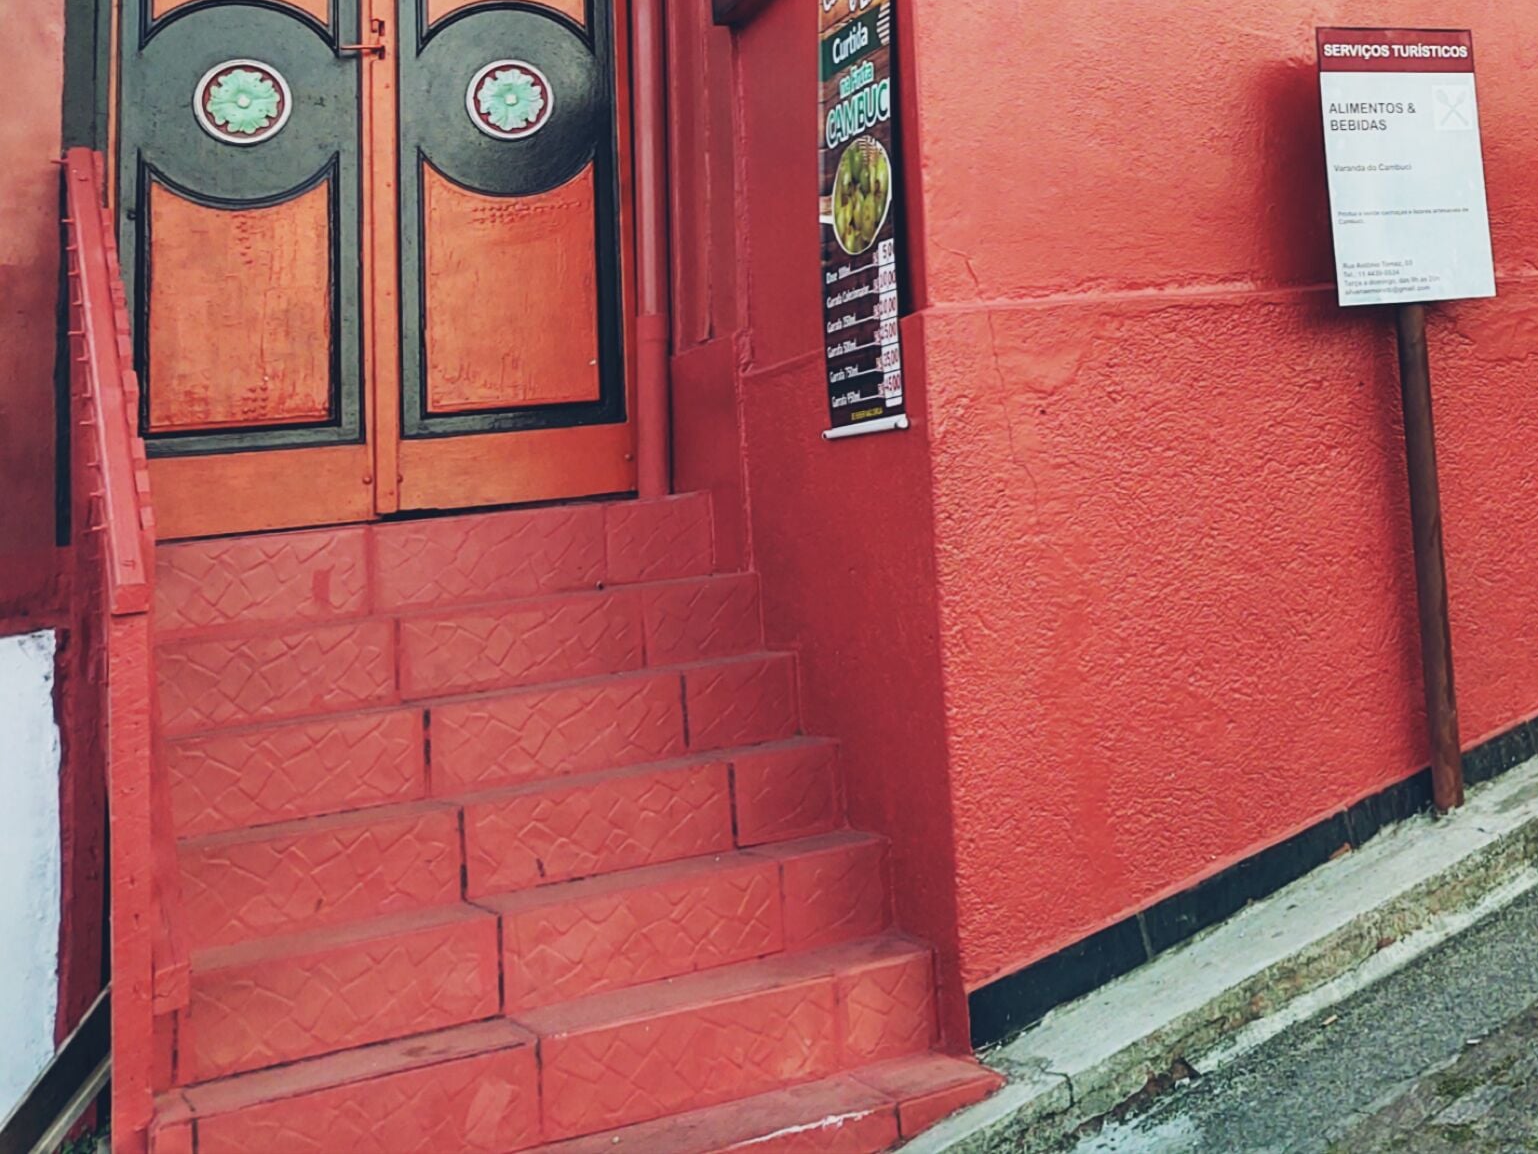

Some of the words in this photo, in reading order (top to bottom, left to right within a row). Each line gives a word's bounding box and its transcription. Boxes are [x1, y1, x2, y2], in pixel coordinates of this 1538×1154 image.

[832, 22, 869, 65] Curtida
[1323, 44, 1390, 59] SERVIÇOS
[1391, 43, 1468, 58] TURÍSTICOS
[825, 77, 890, 149] CAMBUC
[1329, 102, 1404, 114] ALIMENTOS
[1407, 102, 1416, 113] &
[1330, 119, 1387, 131] BEBIDAS
[1333, 164, 1365, 172] Varanda
